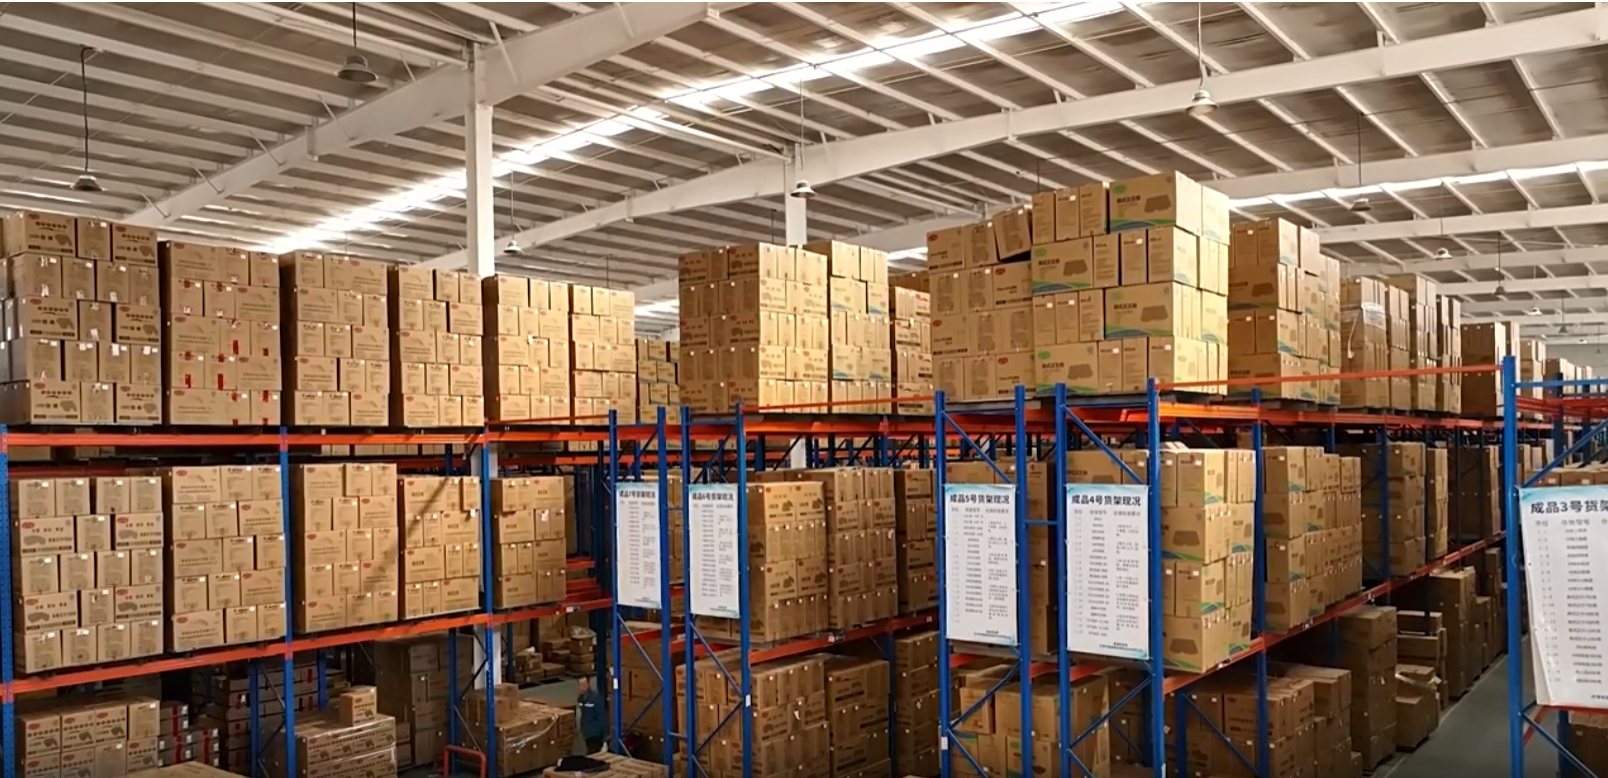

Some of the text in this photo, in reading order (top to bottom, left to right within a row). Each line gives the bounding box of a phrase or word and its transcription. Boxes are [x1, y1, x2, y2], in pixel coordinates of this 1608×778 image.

[949, 493, 1010, 504] 成品5号货架现况
[1071, 495, 1141, 506] 成品4号货架现况
